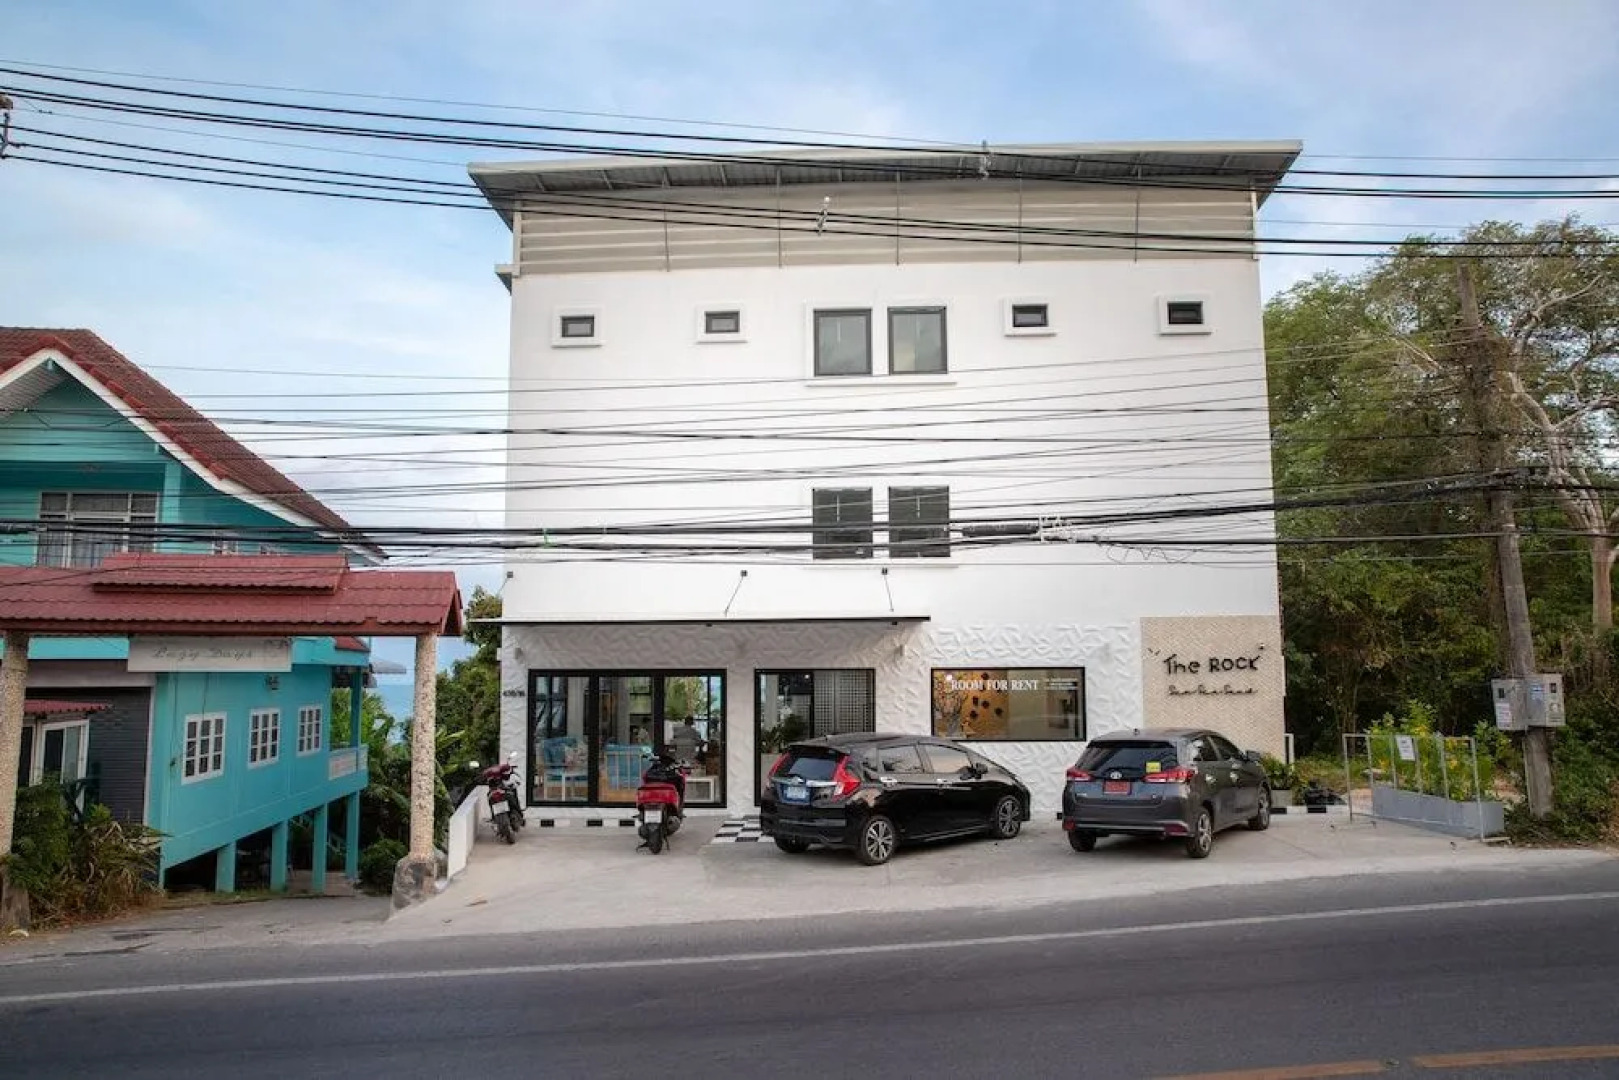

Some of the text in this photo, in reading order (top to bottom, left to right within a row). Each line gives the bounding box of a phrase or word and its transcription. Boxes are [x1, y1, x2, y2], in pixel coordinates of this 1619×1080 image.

[1163, 653, 1261, 675] The ROCK
[951, 679, 984, 691] ROOM
[987, 679, 1009, 691] FOR
[1011, 679, 1039, 691] RENT
